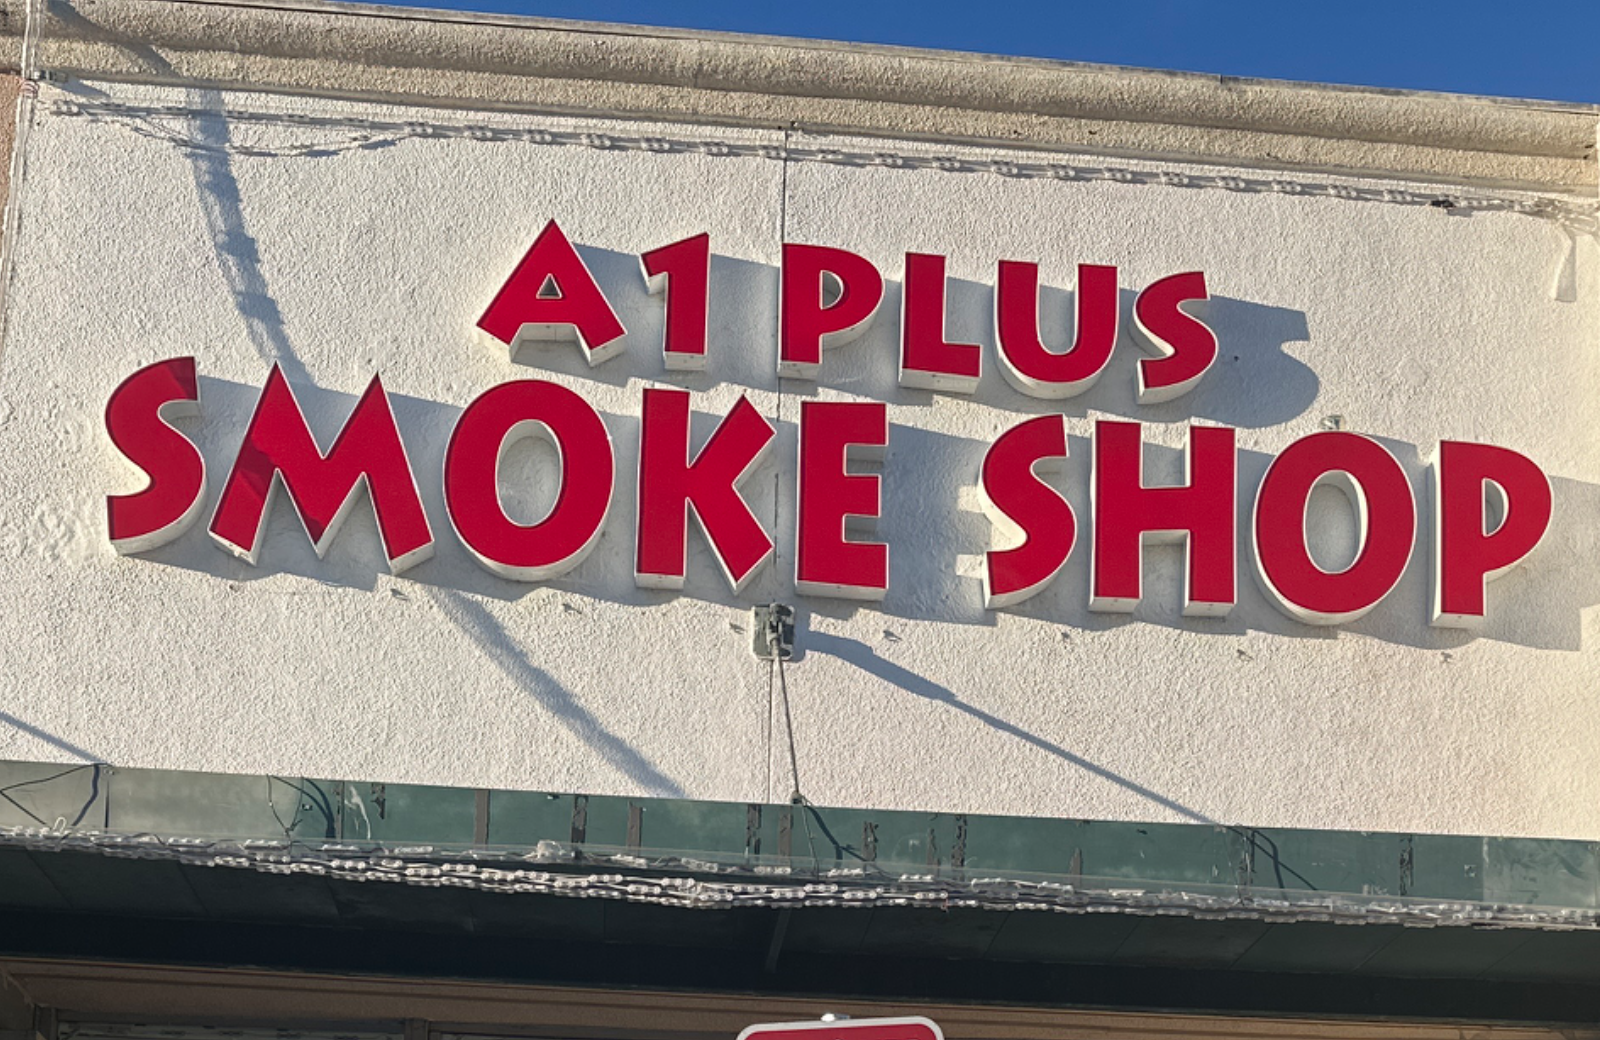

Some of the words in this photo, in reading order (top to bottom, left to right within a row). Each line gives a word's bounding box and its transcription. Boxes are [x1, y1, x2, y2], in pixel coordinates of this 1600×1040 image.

[476, 219, 710, 367] A1
[778, 243, 1219, 401] PLUS
[105, 356, 888, 594] SMOKE
[981, 413, 1553, 621] SHOP
